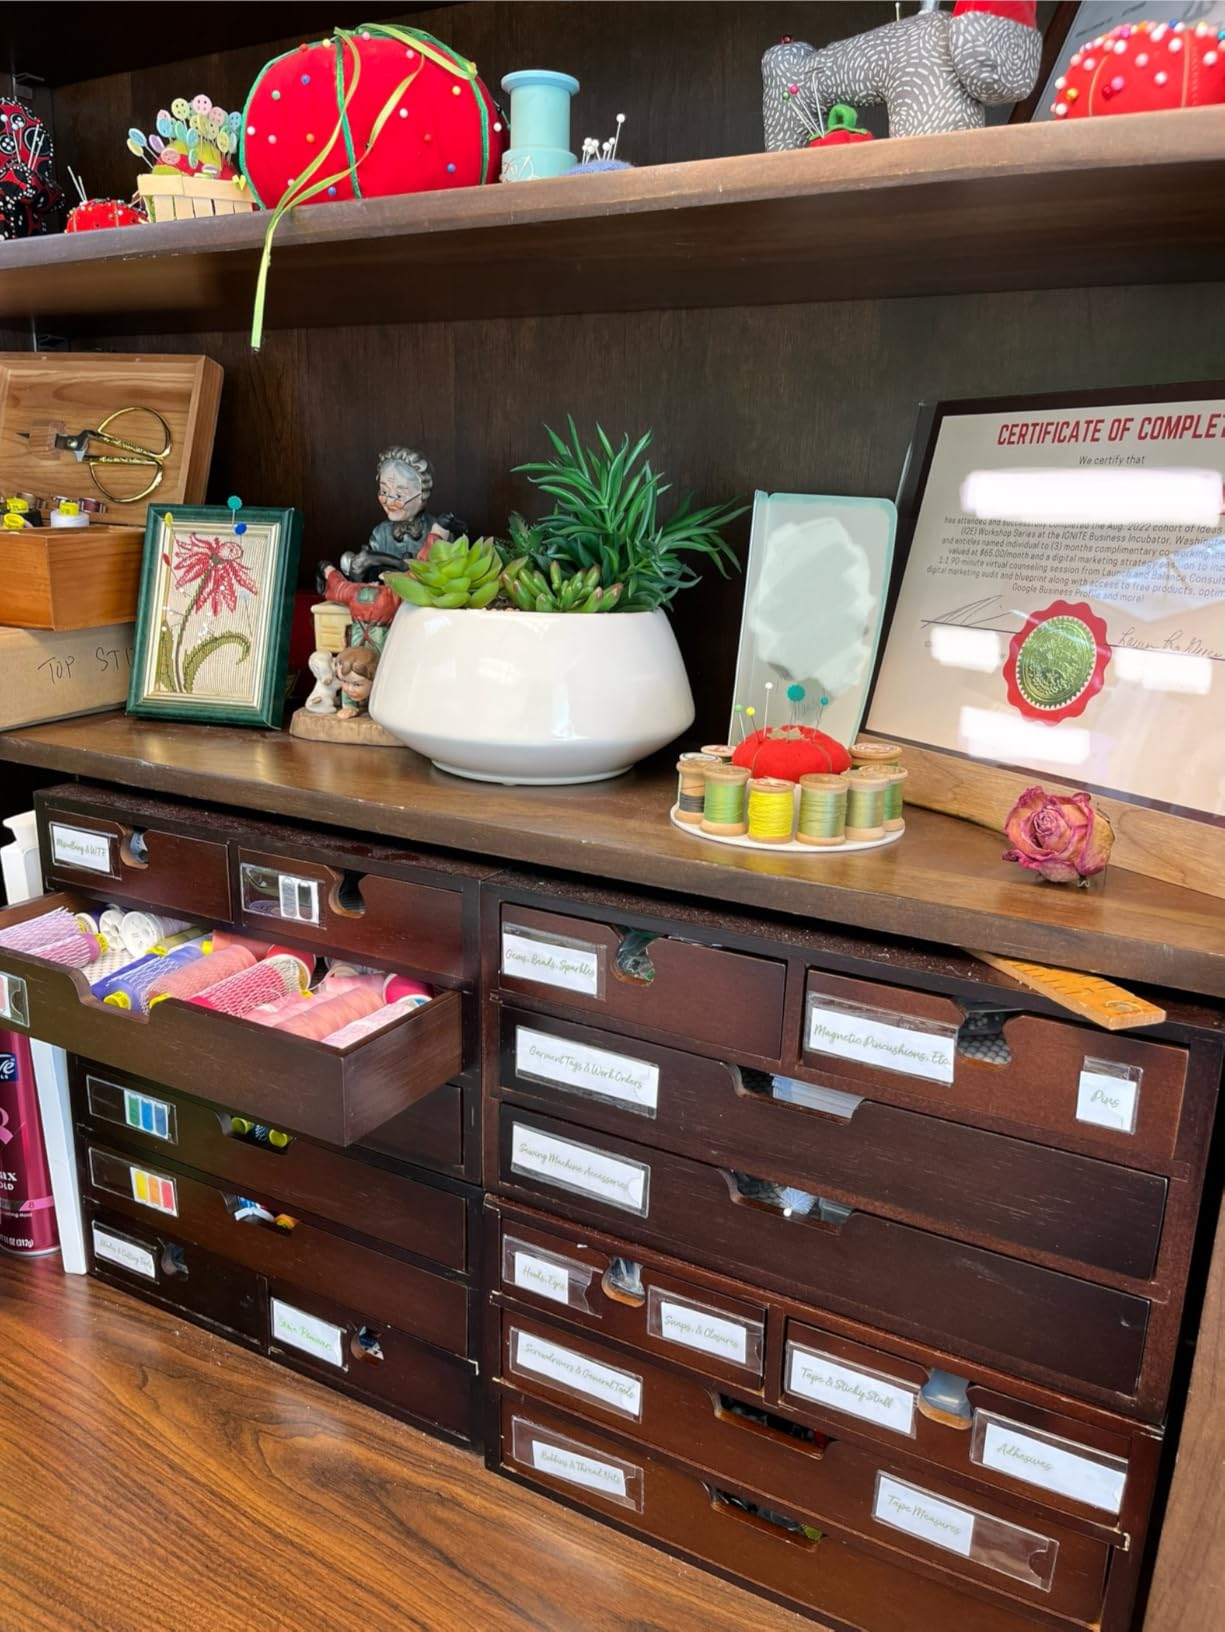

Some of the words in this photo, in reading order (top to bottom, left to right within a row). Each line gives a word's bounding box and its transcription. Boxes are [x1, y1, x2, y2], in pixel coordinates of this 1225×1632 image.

[998, 419, 1104, 446] CERTIFICATE
[1107, 417, 1134, 442] OF
[1079, 455, 1092, 465] We
[1094, 454, 1124, 466] certify
[1126, 455, 1145, 465] that
[978, 527, 1011, 538] Workshop
[1013, 528, 1036, 538] Series
[1037, 530, 1046, 539] at
[1047, 530, 1060, 540] the
[1061, 530, 1087, 540] IGNITE
[1089, 531, 1127, 542] Business
[1127, 522, 1152, 531] 2022
[981, 540, 1004, 548] named
[1005, 540, 1039, 549] individual
[1050, 541, 1062, 552] (3)
[1063, 543, 1092, 553] months
[1094, 544, 1156, 557] complimentary
[986, 560, 1009, 569] virtual
[1009, 561, 1048, 573] counseling
[1050, 564, 1080, 574] session
[1081, 565, 1101, 576] from
[1031, 551, 1044, 561] and
[1052, 552, 1077, 564] digital
[1079, 556, 1118, 567] marketing
[1014, 571, 1047, 583] blueprint
[1048, 574, 1070, 586] along
[1012, 582, 1038, 594] Google
[1039, 585, 1074, 596] Business
[37, 655, 75, 684] TOP
[95, 646, 133, 672] STI
[814, 1023, 862, 1045] Magnetic
[528, 1045, 564, 1065] Garment
[1090, 1089, 1121, 1108] Pins
[800, 1367, 824, 1384] Tape
[833, 1379, 865, 1402] Sticky
[866, 1390, 894, 1409] Stuff
[996, 1443, 1054, 1472] Adhesives
[888, 1494, 912, 1512] Tape
[912, 1505, 961, 1536] Measures
